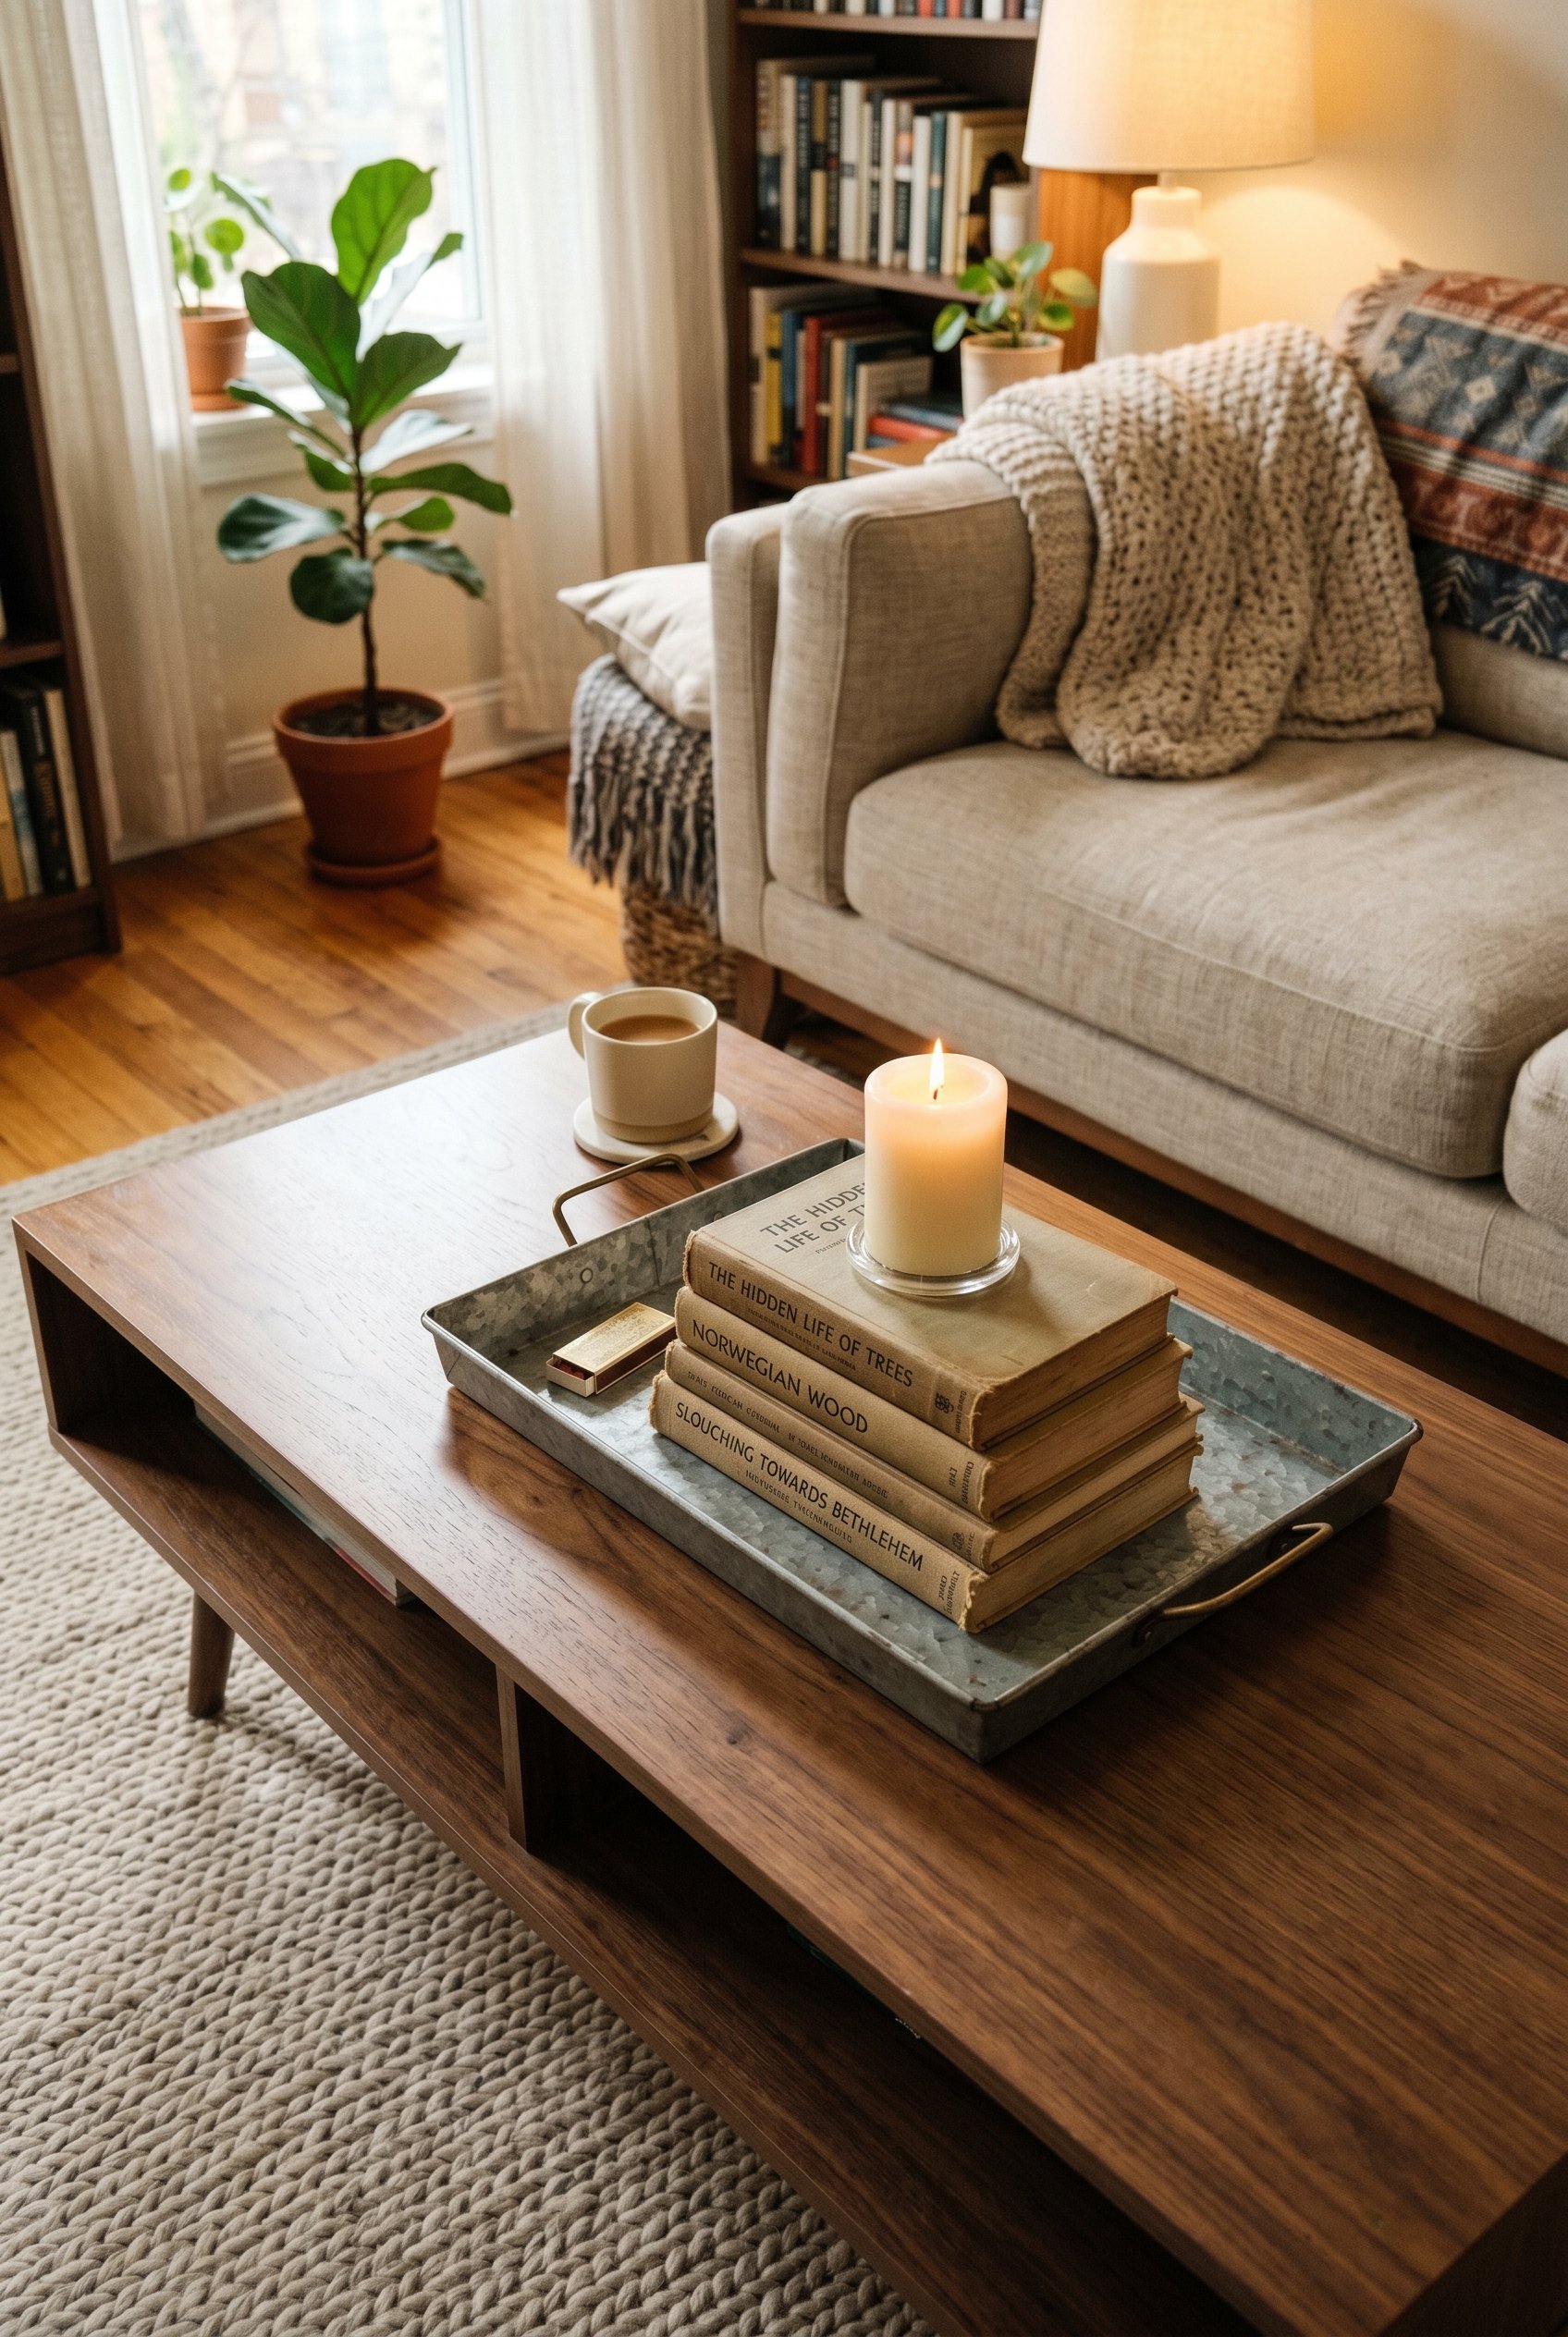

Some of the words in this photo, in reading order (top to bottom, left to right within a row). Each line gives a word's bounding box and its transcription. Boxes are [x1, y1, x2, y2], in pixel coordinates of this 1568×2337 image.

[760, 1215, 807, 1237] THE
[805, 1182, 864, 1218] HIDDE
[774, 1230, 820, 1254] LIFE
[820, 1215, 848, 1232] OF
[692, 1319, 802, 1397] NORWEGIAN
[808, 1385, 868, 1435] WOOD
[708, 1261, 737, 1291] THE
[741, 1282, 798, 1325] HIDDEN
[803, 1313, 835, 1344] LIFE
[839, 1334, 861, 1357] OF
[865, 1347, 913, 1389] TREES
[675, 1401, 754, 1463] SLOUCHING
[760, 1452, 828, 1510] TOWARDS
[832, 1500, 924, 1572] BETHLEHEM
